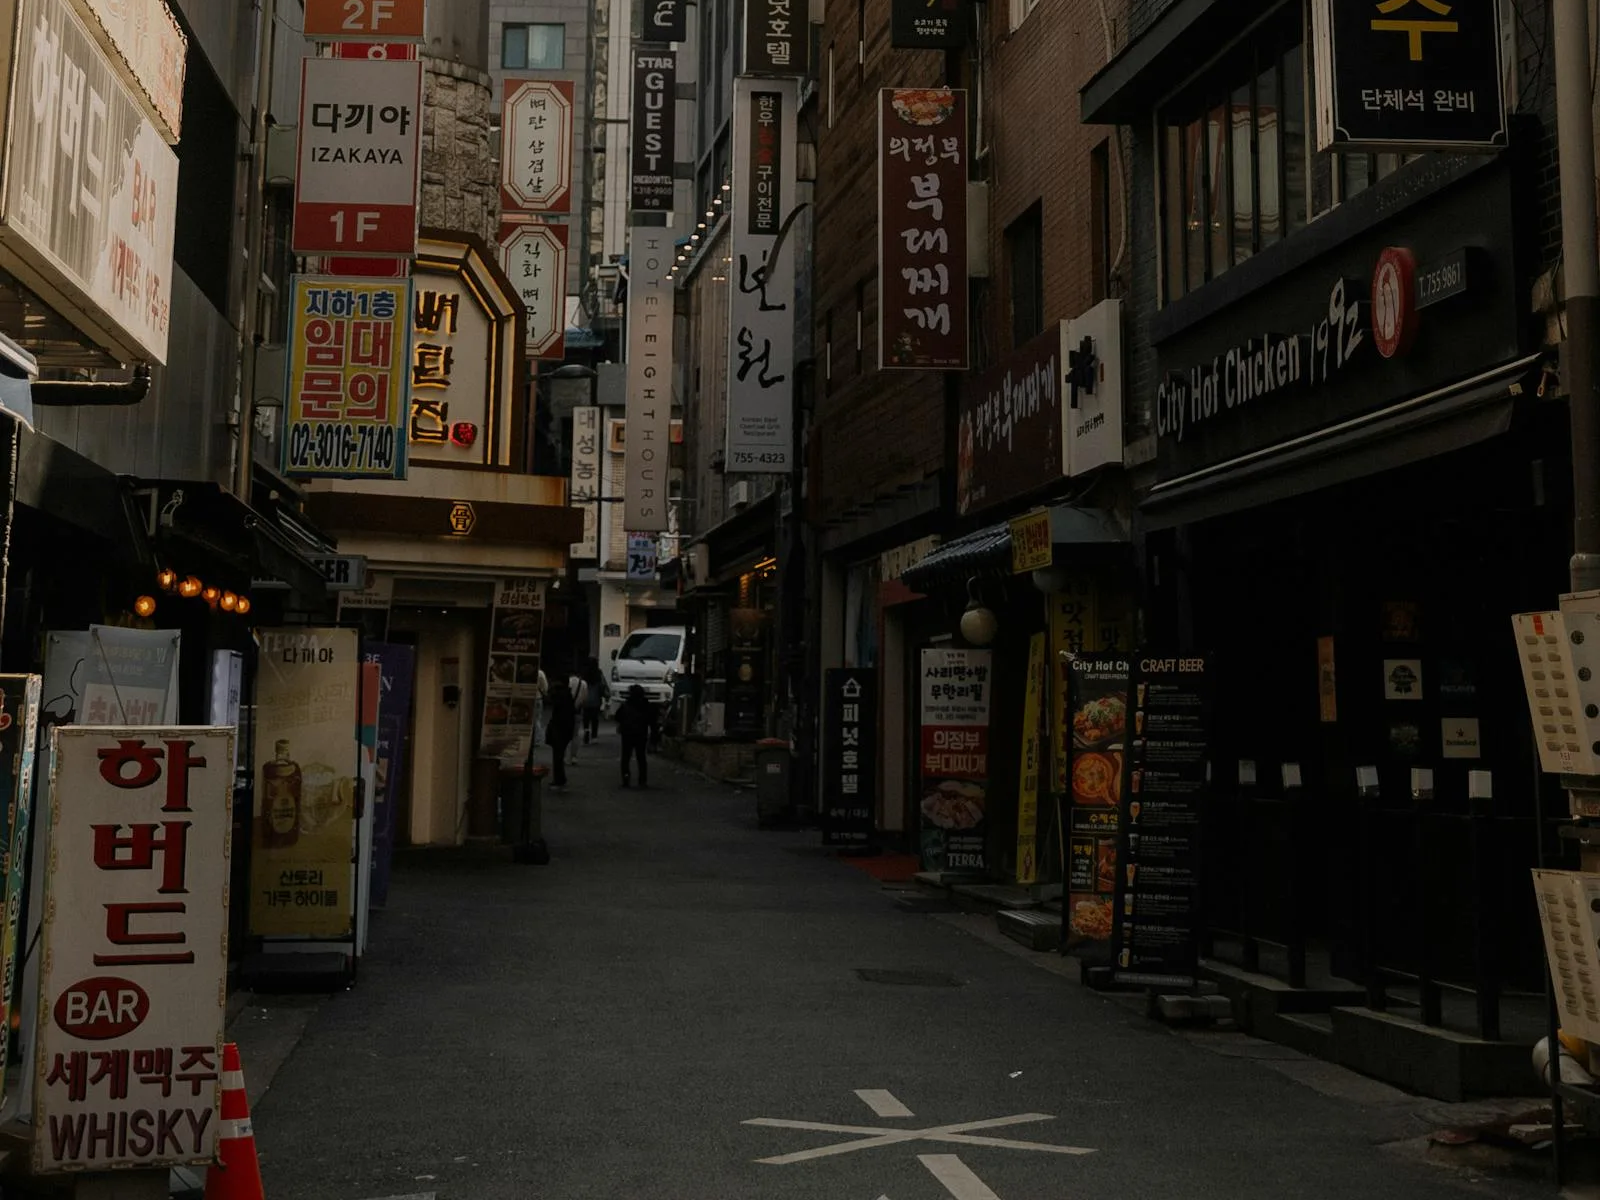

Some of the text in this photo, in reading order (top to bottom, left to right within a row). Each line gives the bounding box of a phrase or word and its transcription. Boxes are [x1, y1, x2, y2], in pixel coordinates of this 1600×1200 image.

[637, 57, 674, 70] STAR
[311, 101, 410, 135] 다끼야
[1361, 88, 1475, 114] 단체석 완비
[644, 72, 664, 171] GUEST
[311, 146, 404, 166] IZAKAYA
[889, 135, 960, 167] 의정부
[131, 158, 157, 247] BAR
[329, 210, 380, 240] 1F
[900, 171, 953, 337] 부대찌개
[643, 239, 659, 324] HOTEL
[306, 289, 394, 318] 지하1층
[304, 319, 394, 370] 임대
[1157, 371, 1186, 443] City
[1191, 356, 1219, 424] Hof
[1225, 333, 1300, 408] Chicken
[1310, 275, 1364, 385] 1992
[300, 370, 389, 421] 문의
[641, 334, 657, 421] EIGHT
[290, 424, 394, 472] 02-3016-7140
[735, 452, 785, 464] 755-4323
[640, 429, 655, 519] HOURS
[283, 648, 334, 663] 다끼야
[1072, 661, 1092, 672] City
[1095, 661, 1113, 671] Hof
[1140, 659, 1205, 673] CRAFT BEER
[90, 739, 206, 967] 하버드
[947, 852, 985, 868] TERRA
[279, 870, 323, 887] 산토리
[66, 989, 141, 1027] BAR
[47, 1045, 219, 1101] 세계맥주
[49, 1108, 212, 1161] WHISKY
